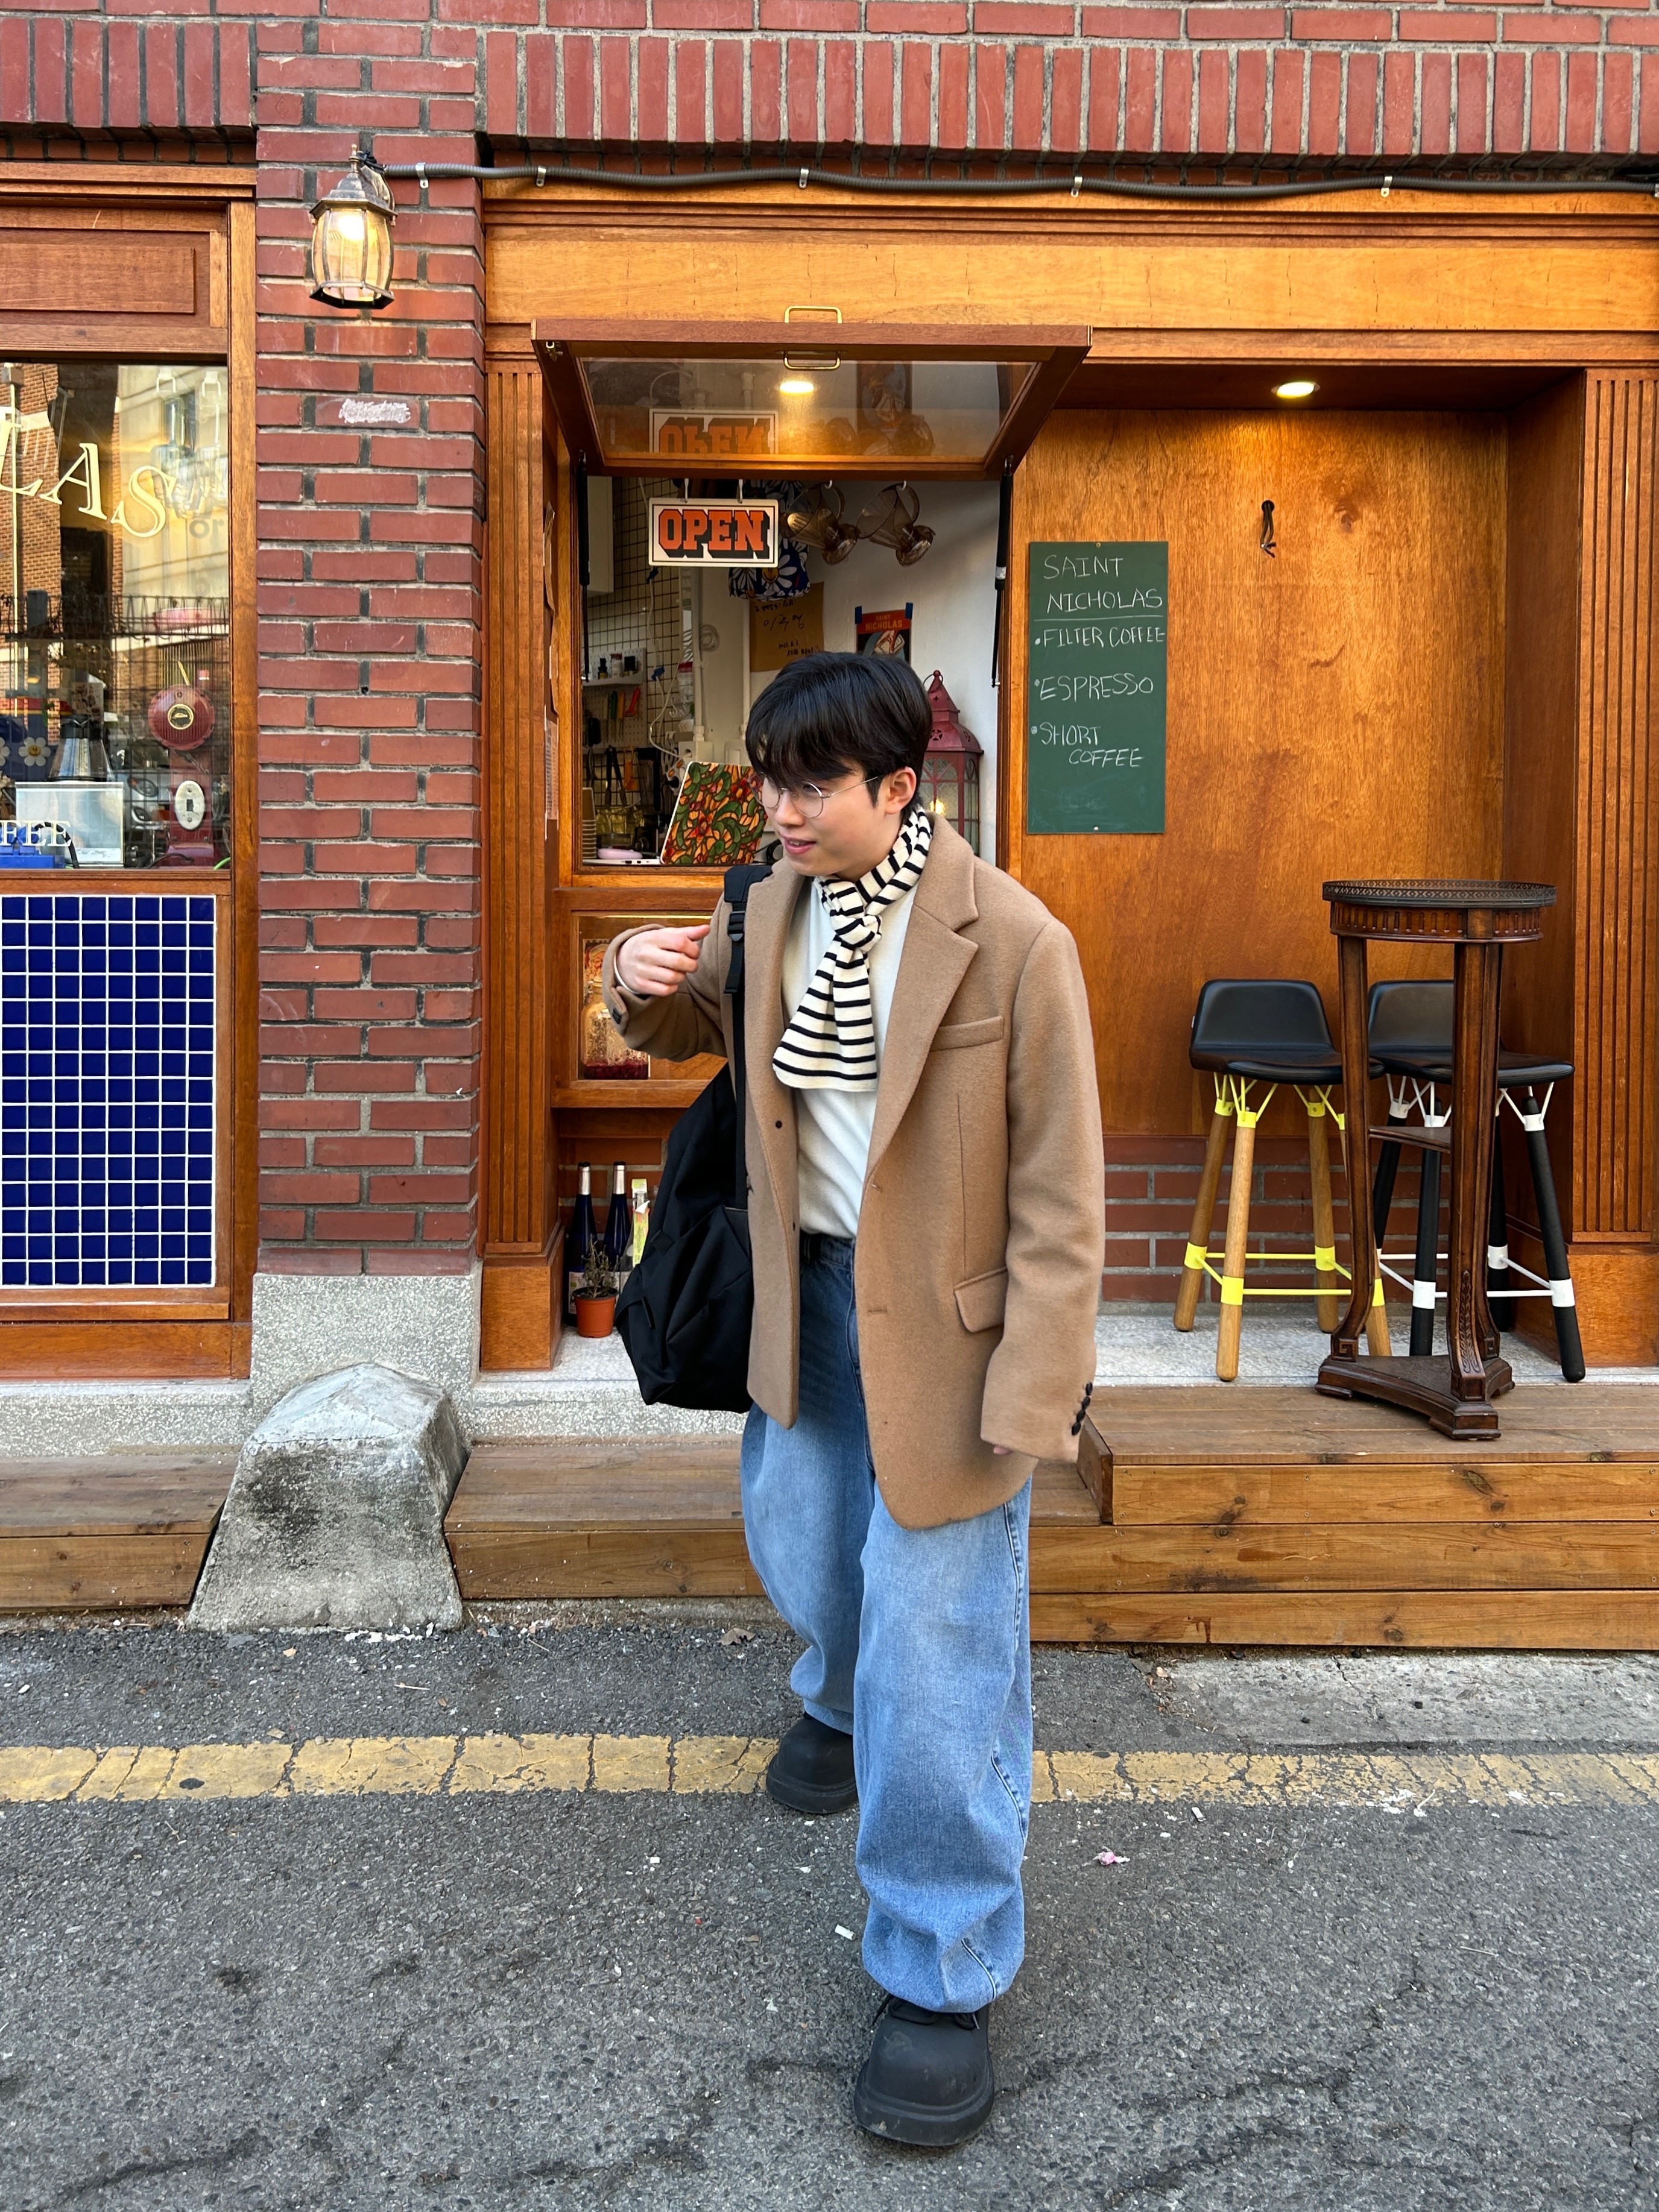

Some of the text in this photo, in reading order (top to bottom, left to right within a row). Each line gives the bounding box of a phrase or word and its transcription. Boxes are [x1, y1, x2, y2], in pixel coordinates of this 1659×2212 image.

[659, 509, 769, 558] OPEN
[1044, 555, 1123, 578] SAINT
[1047, 588, 1163, 614] NICHOLAS
[865, 619, 903, 631] NICHOLAS
[1043, 625, 1165, 648] FILTER COFFEE
[1039, 672, 1154, 702] ESPRESSO
[1040, 722, 1101, 746] SHORT
[1069, 748, 1144, 767] COFFEE
